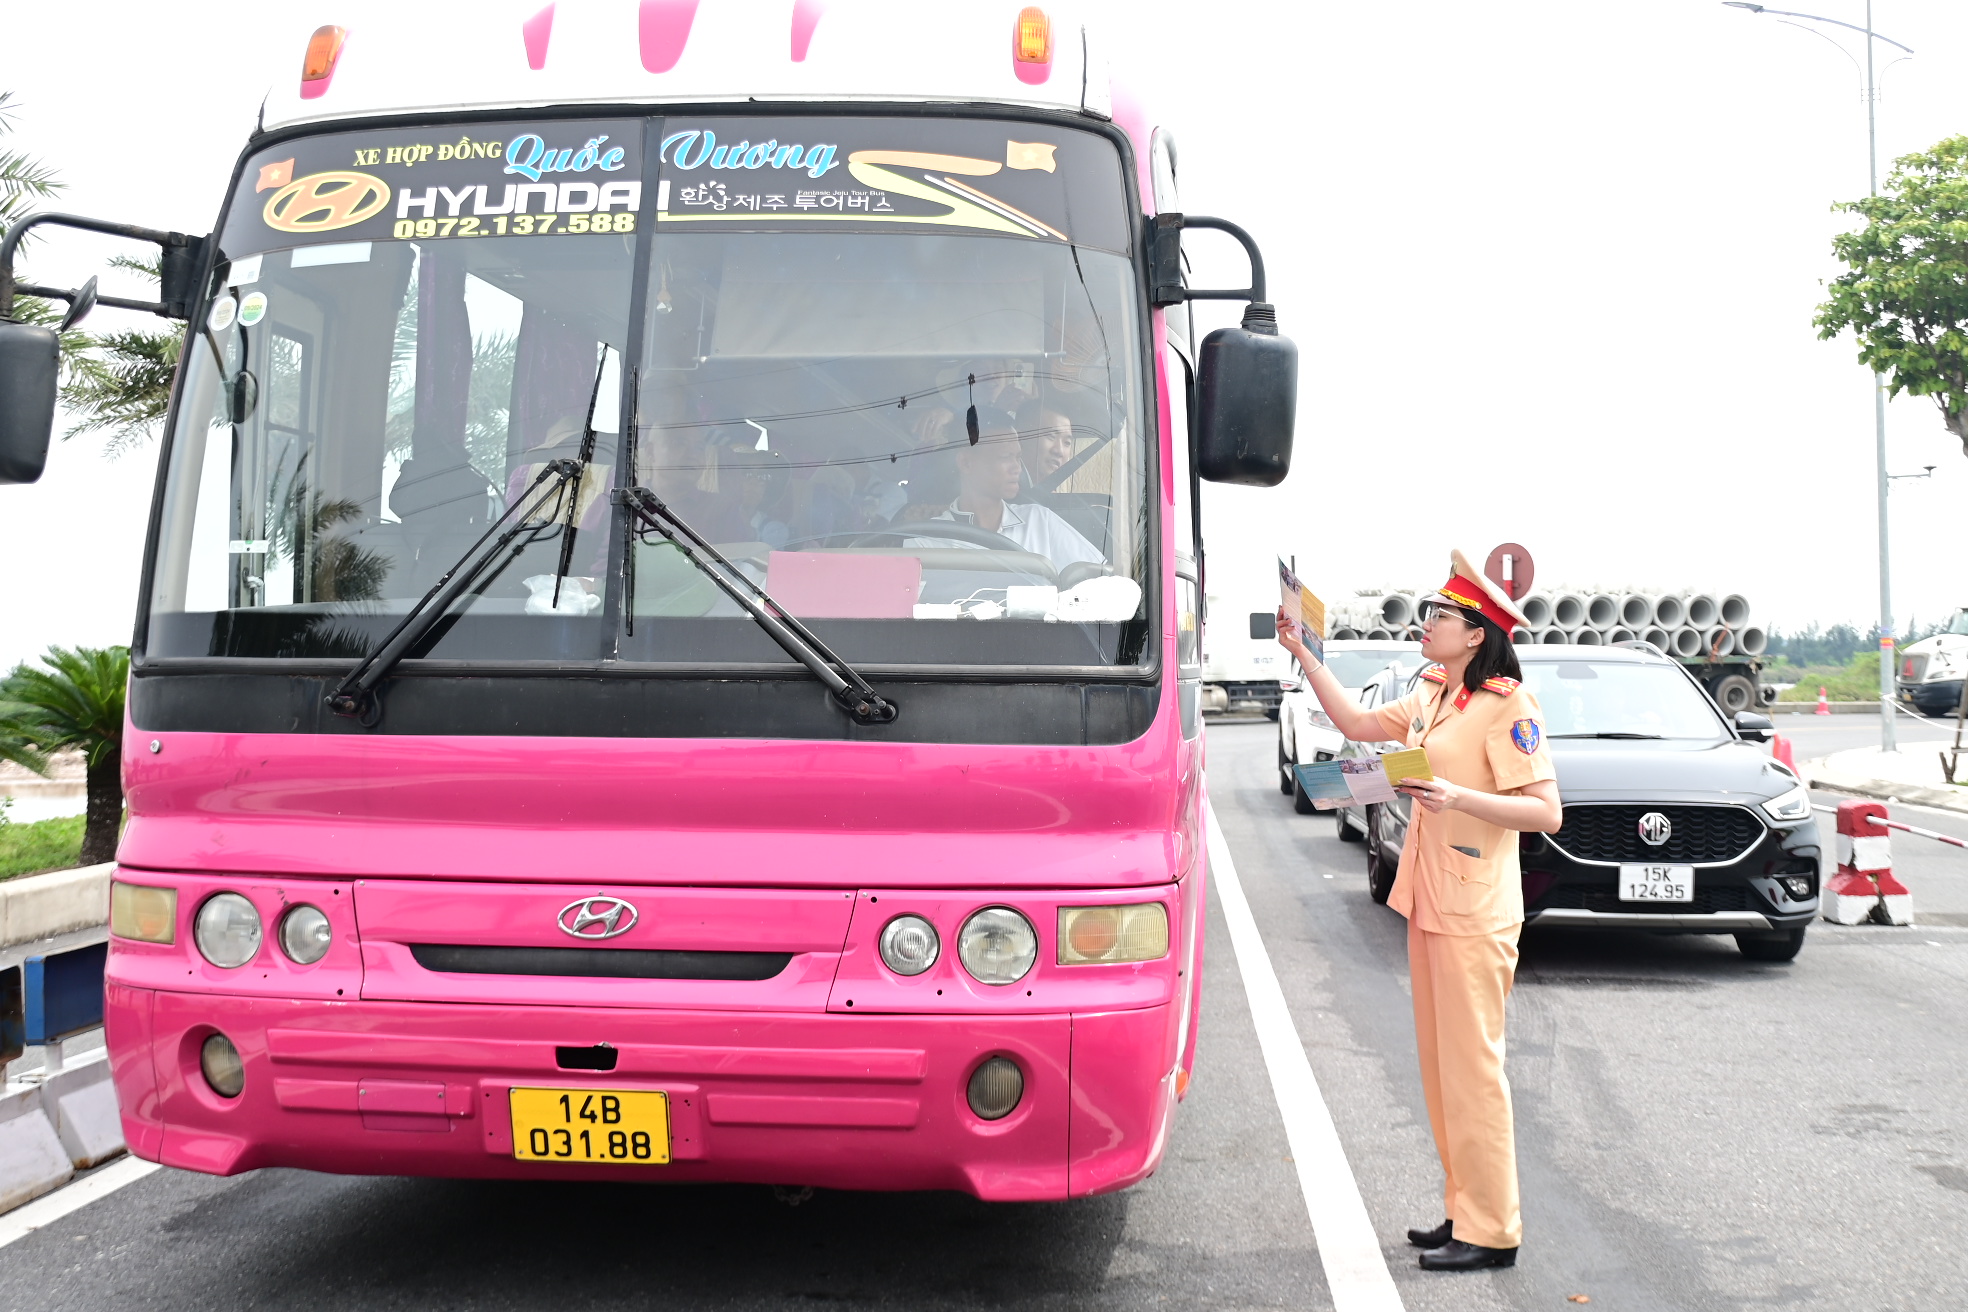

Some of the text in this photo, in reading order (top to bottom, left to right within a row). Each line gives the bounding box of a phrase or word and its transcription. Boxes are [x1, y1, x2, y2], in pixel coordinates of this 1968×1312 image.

[353, 136, 503, 167] XE HỢP ĐỒNG
[503, 129, 840, 183] Quốc Vương
[393, 212, 636, 239] 0972.137.588
[1643, 867, 1672, 882] 15K
[1629, 884, 1685, 899] 124.95
[559, 1094, 621, 1124] 14B
[529, 1128, 652, 1159] 031.88
